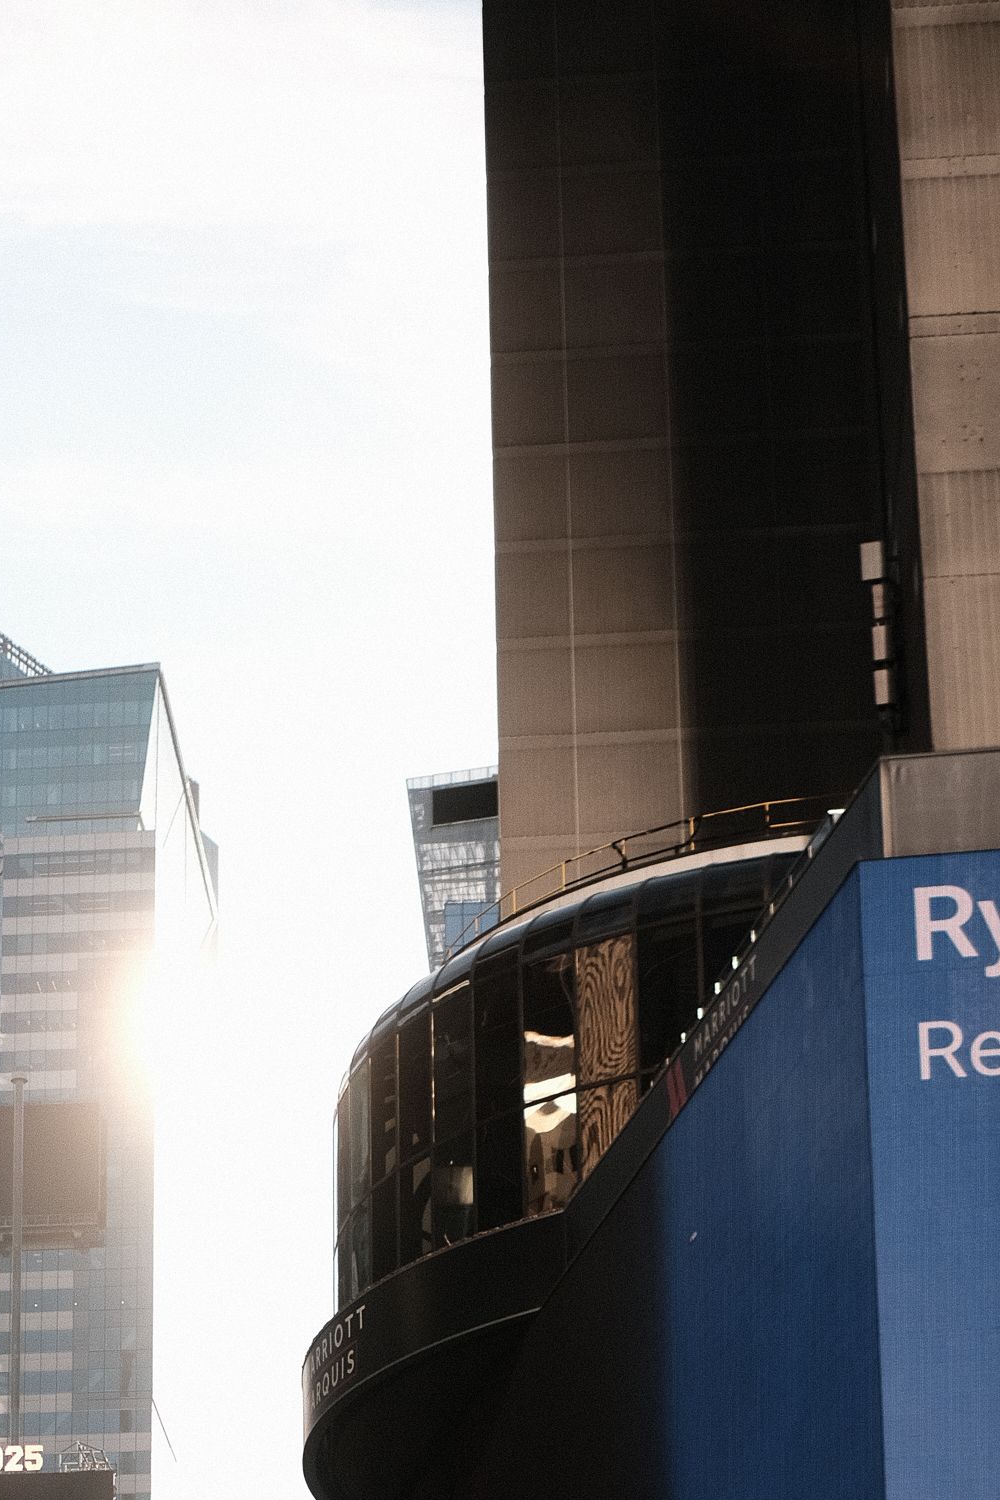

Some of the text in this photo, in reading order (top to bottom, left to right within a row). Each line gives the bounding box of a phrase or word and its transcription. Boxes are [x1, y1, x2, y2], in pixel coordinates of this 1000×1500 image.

[694, 954, 757, 1062] MARRIOTT
[309, 1304, 366, 1379] ARRIOTT
[310, 1348, 355, 1408] ARQUIS
